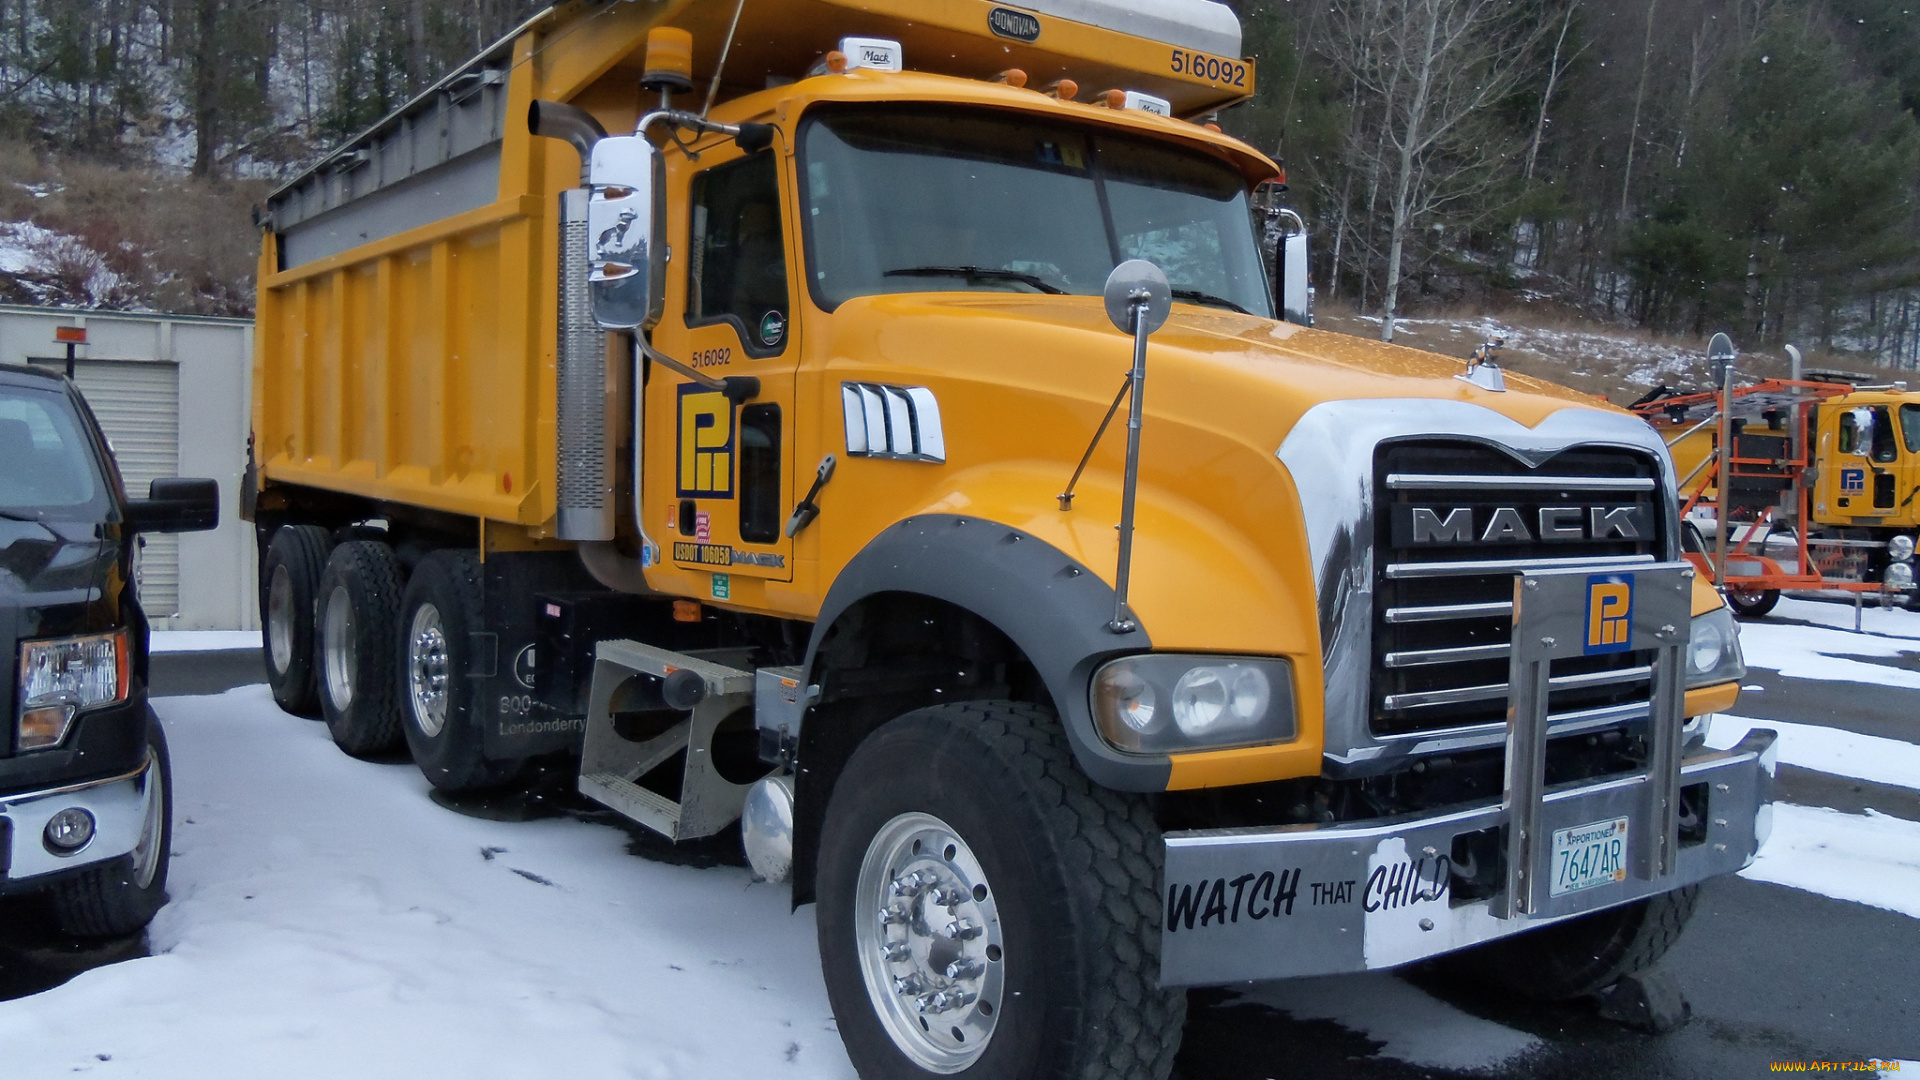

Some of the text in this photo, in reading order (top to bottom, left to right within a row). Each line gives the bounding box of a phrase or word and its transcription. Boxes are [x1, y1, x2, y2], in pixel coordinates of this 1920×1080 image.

[994, 11, 1037, 36] DONOVAN
[863, 50, 891, 64] Mack
[1412, 507, 1640, 542] MACK
[675, 543, 731, 565] USDOT 106058
[731, 550, 785, 568] MACK
[500, 717, 587, 736] Londonderry
[1567, 828, 1615, 847] APPORTIONED
[1559, 839, 1621, 886] 7647AR
[1167, 854, 1452, 932] WATCH THAT CHILD
